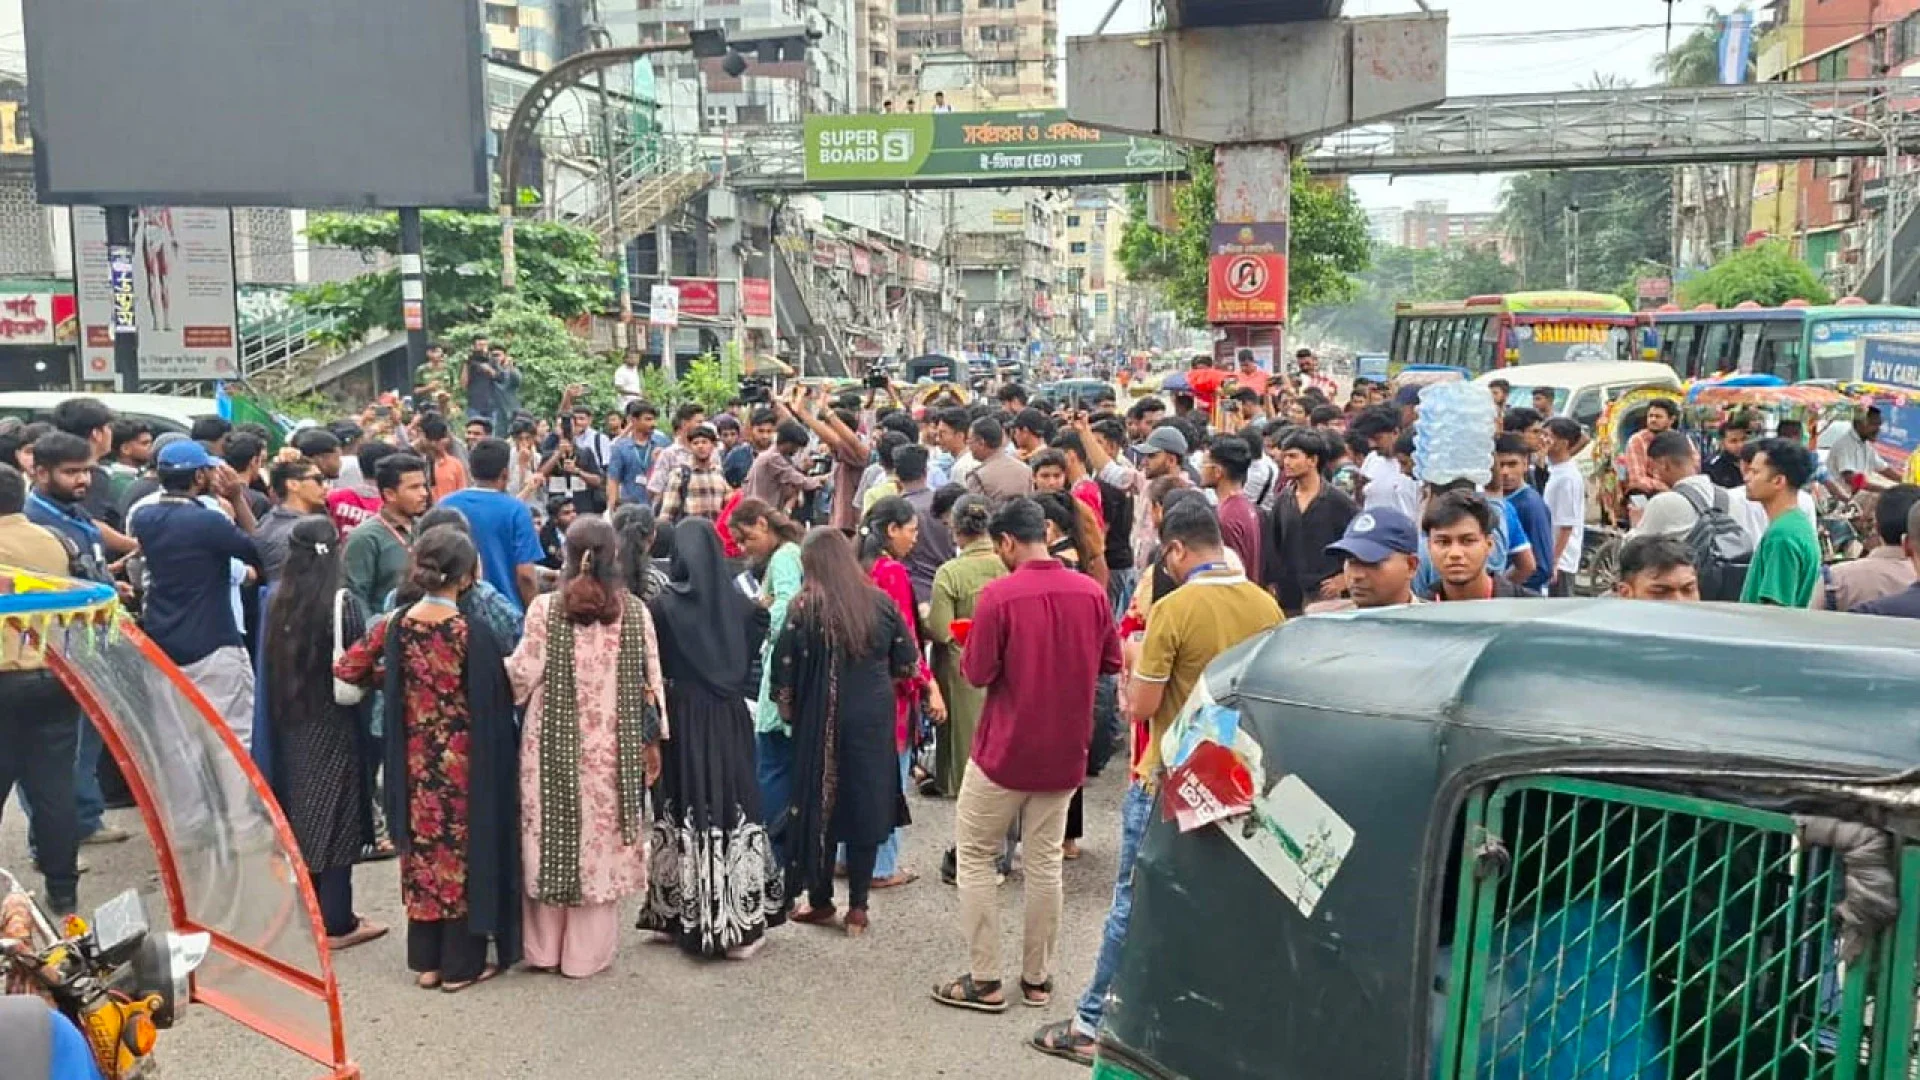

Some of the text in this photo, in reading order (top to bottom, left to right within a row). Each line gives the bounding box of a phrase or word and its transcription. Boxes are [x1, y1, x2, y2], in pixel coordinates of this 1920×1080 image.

[819, 129, 879, 147] SUPER
[1026, 125, 1039, 141] ও
[819, 147, 880, 163] BOARD
